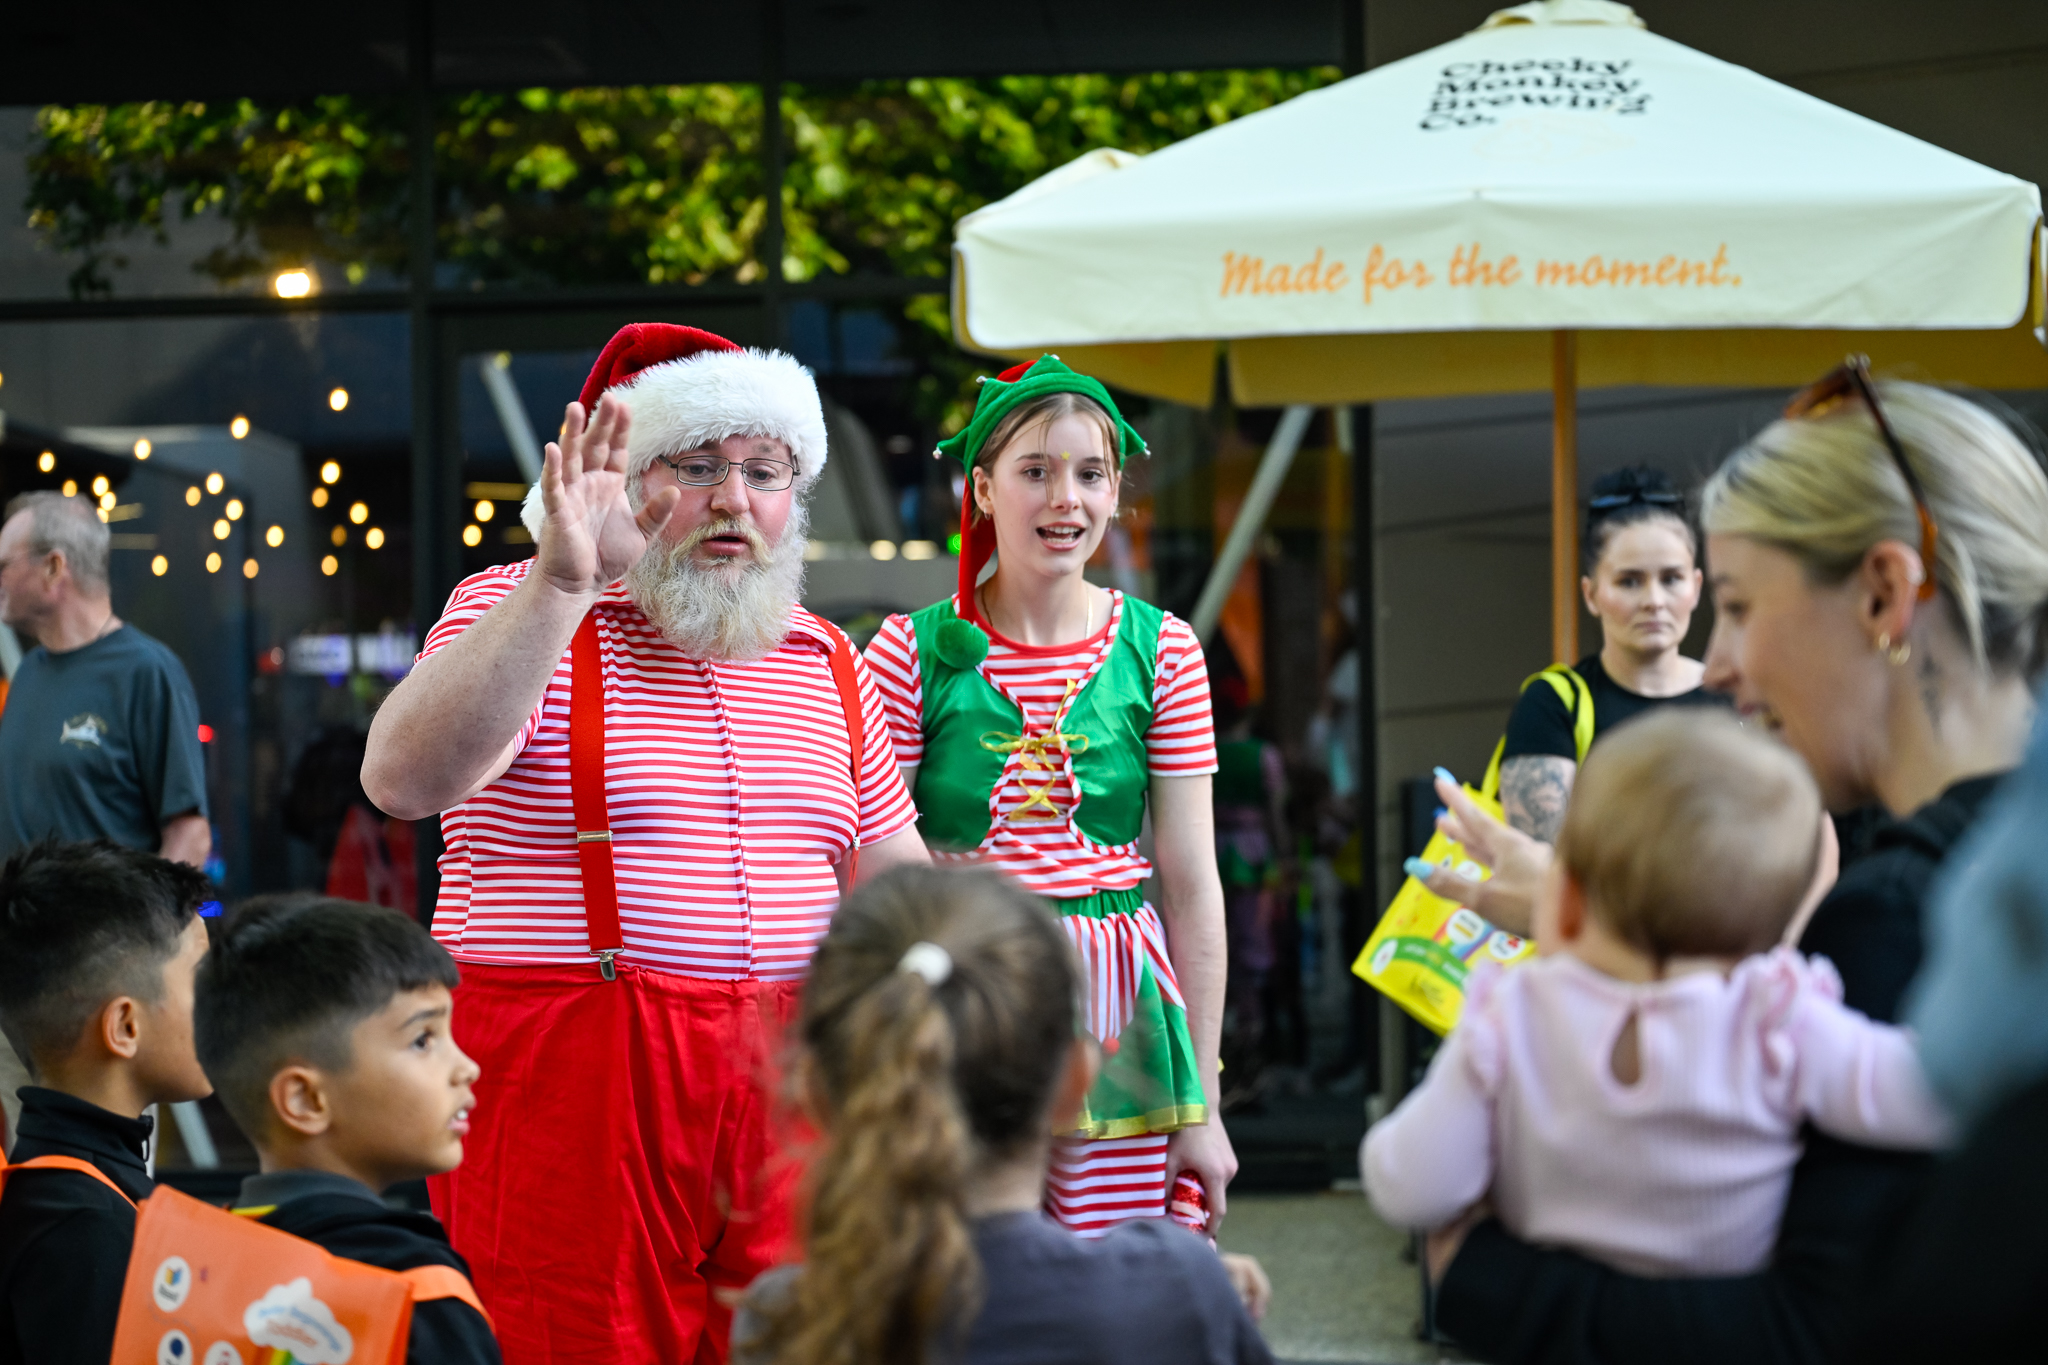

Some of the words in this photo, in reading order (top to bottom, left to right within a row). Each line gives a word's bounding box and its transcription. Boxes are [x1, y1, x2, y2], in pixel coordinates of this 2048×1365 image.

[1441, 57, 1632, 78] Cheeky
[1437, 74, 1639, 94] Monkey
[1430, 94, 1650, 115] Brewing
[1220, 246, 1350, 298] Made
[1362, 243, 1435, 306] for
[1448, 242, 1523, 288] the
[1535, 243, 1743, 288] moment.
